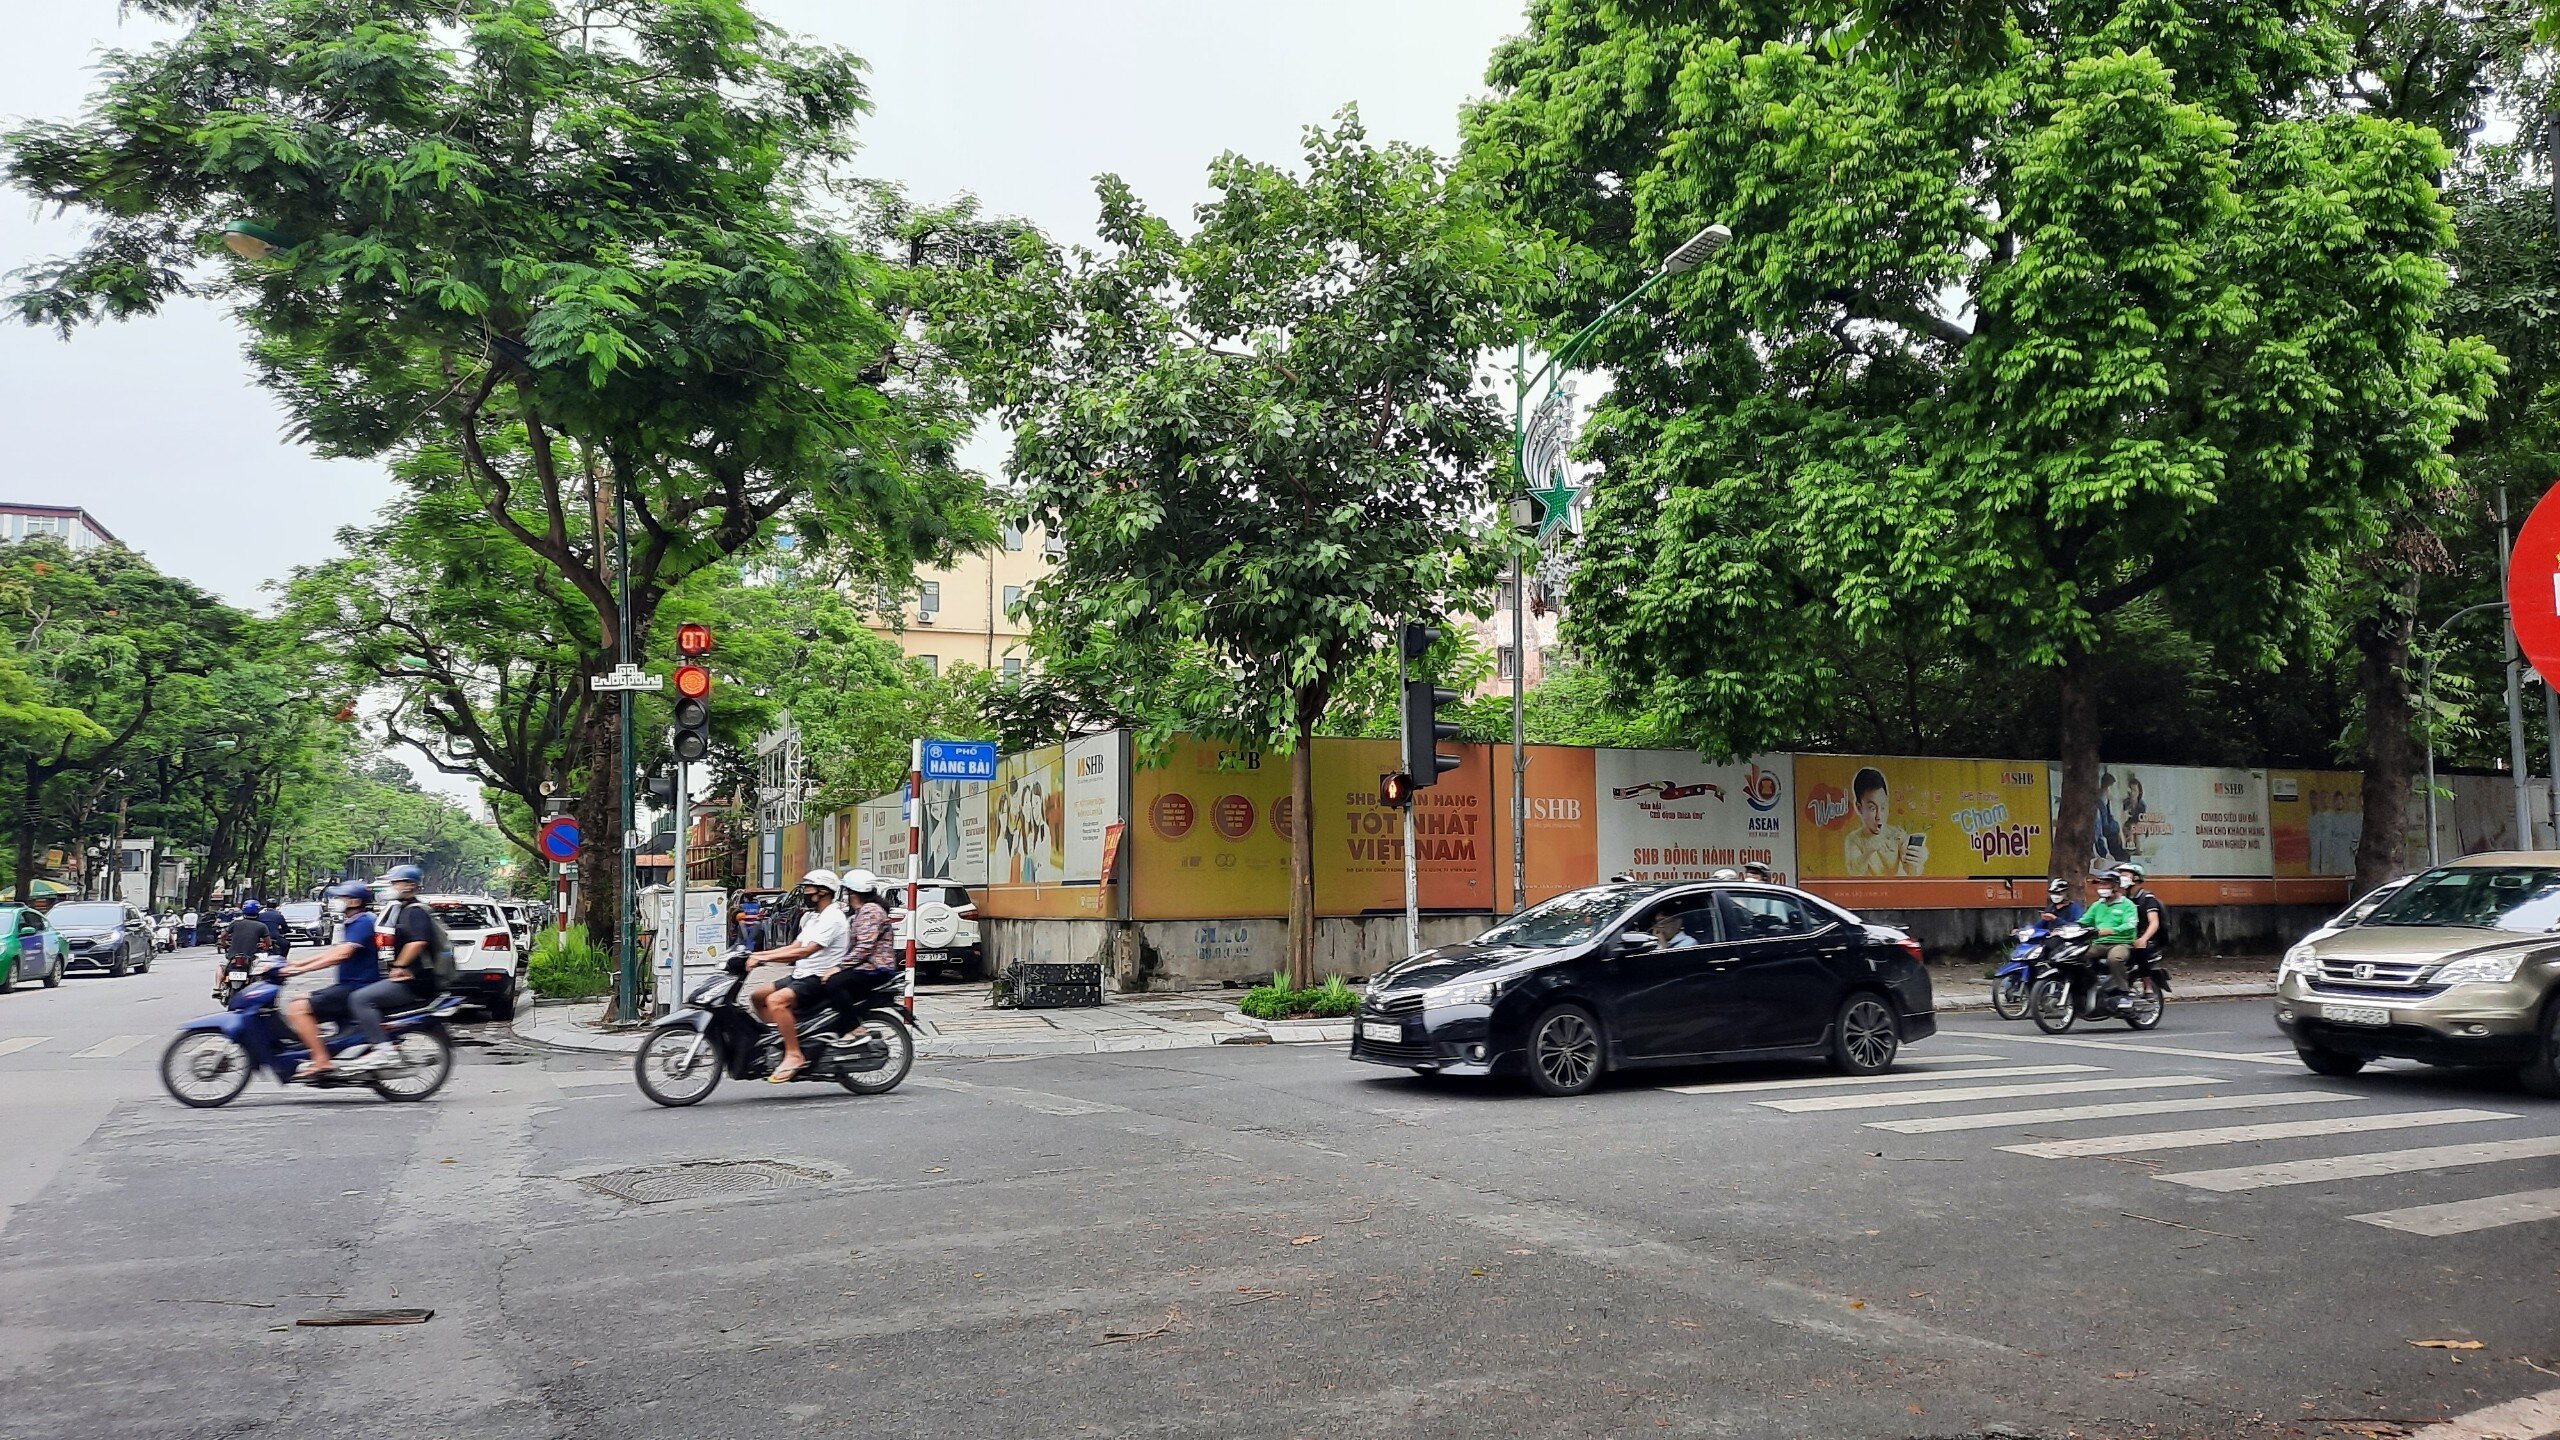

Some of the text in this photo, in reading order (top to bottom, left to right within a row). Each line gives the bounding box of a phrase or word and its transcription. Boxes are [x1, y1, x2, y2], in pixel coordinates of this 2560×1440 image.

[682, 631, 706, 648] 07
[955, 745, 977, 755] PHỐ
[930, 758, 990, 775] HÀNG BÀI
[1085, 754, 1104, 776] SHB
[2010, 772, 2034, 785] SHB
[2224, 782, 2244, 795] SHB
[1534, 798, 1581, 820] SHB
[1346, 805, 1398, 835] TỐT
[1748, 817, 1779, 831] ASEAN
[1346, 835, 1477, 865] VIỆT NAM
[1634, 848, 1658, 865] SHB
[1665, 842, 1698, 865] ĐỒNG
[1703, 845, 1734, 865] HÀNH
